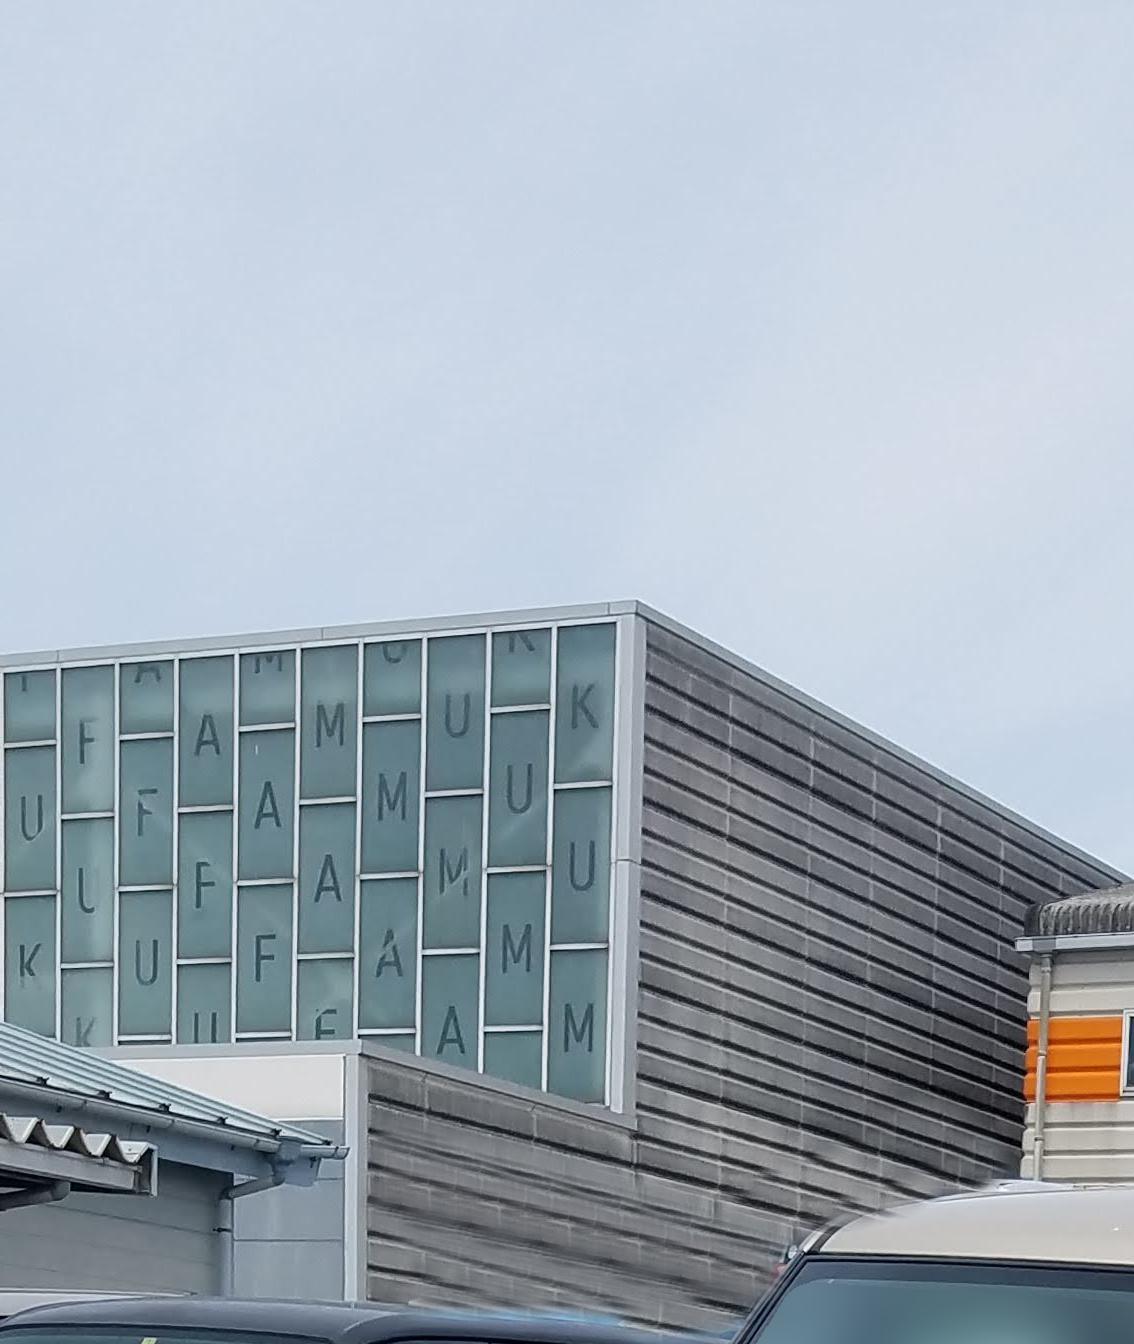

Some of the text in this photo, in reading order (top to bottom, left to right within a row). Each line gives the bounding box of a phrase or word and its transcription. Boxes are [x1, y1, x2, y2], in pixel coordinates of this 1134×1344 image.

[315, 702, 345, 748] M
[444, 693, 471, 738] U
[571, 683, 599, 729] K
[20, 794, 43, 840] U
[254, 781, 281, 829] A
[377, 771, 407, 821] M
[506, 763, 533, 814] U
[314, 854, 342, 903] A
[568, 840, 596, 891] U
[135, 939, 159, 985] U
[255, 933, 277, 982] F
[502, 923, 532, 973] M
